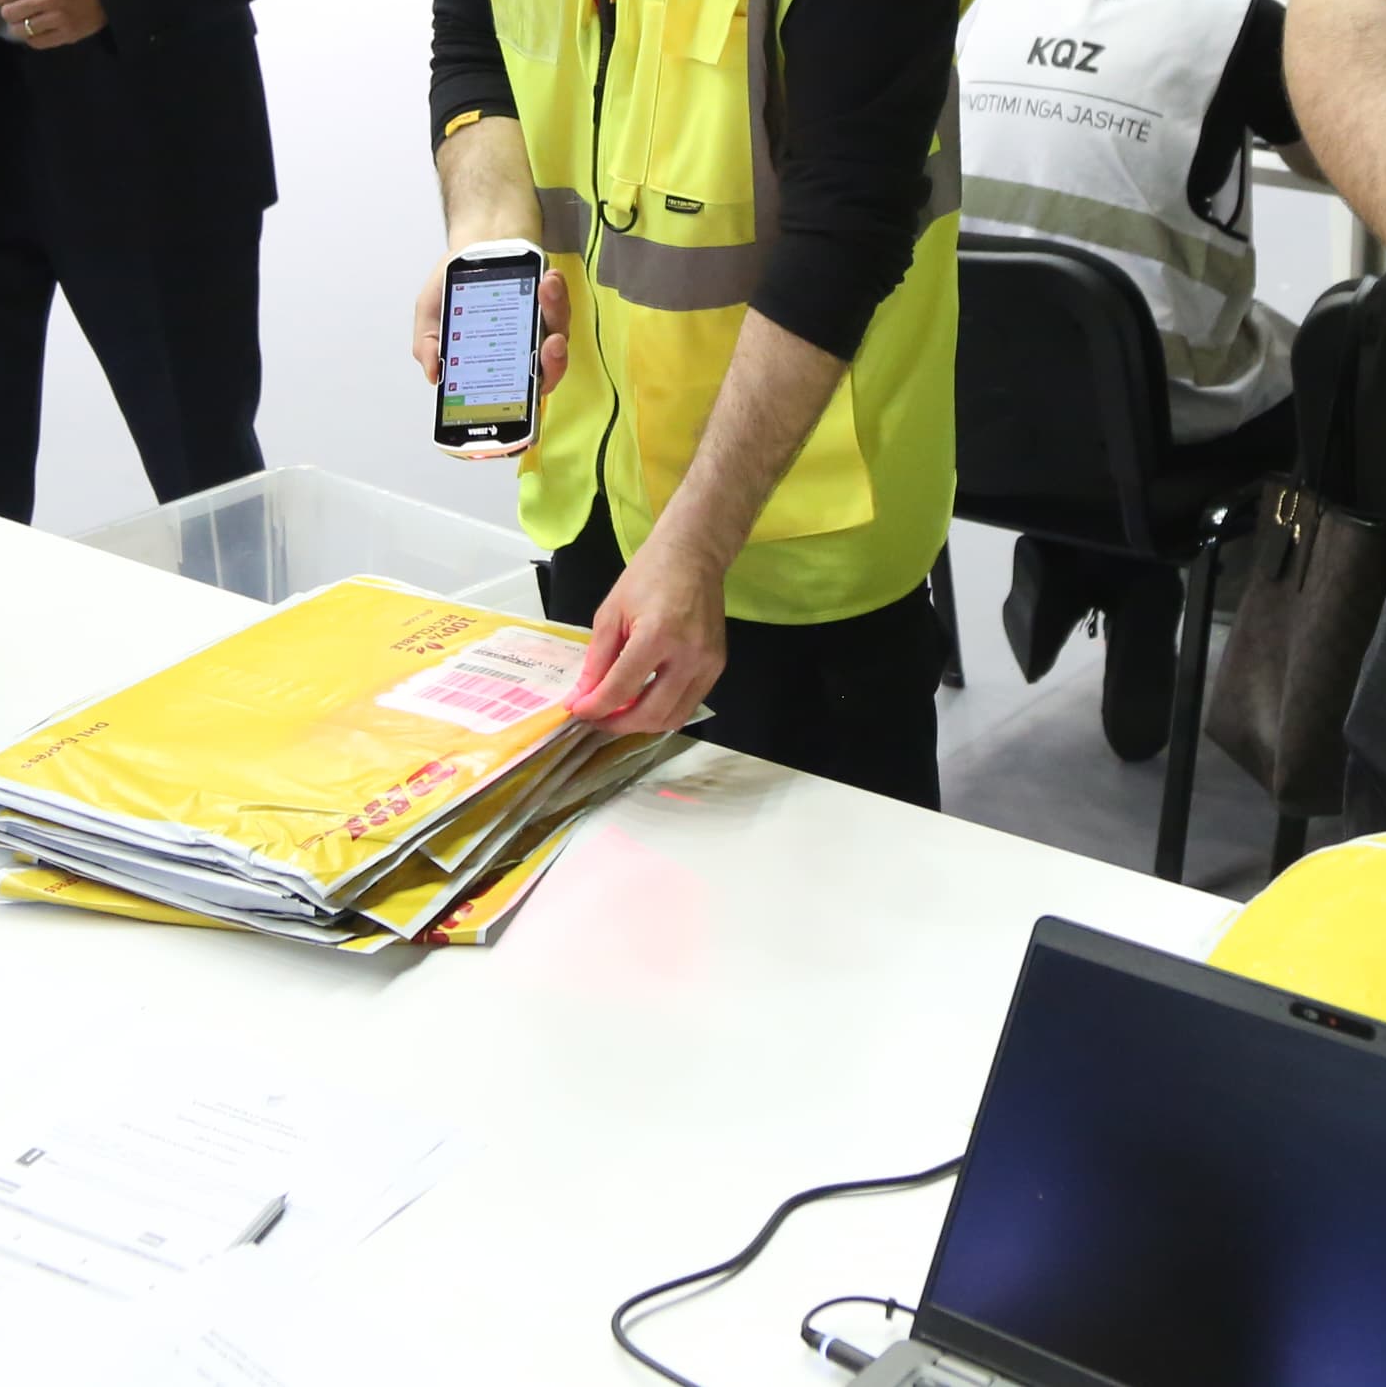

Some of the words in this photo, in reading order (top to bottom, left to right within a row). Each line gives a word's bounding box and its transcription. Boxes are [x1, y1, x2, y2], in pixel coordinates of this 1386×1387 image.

[1026, 36, 1106, 74] KQZ
[967, 93, 1022, 114] VOTIMI
[1025, 97, 1063, 121] NGA
[1066, 104, 1152, 144] JASHTË
[428, 616, 478, 645] 100%
[76, 721, 110, 738] DHL
[21, 737, 80, 769] Express
[345, 760, 458, 843] DHL
